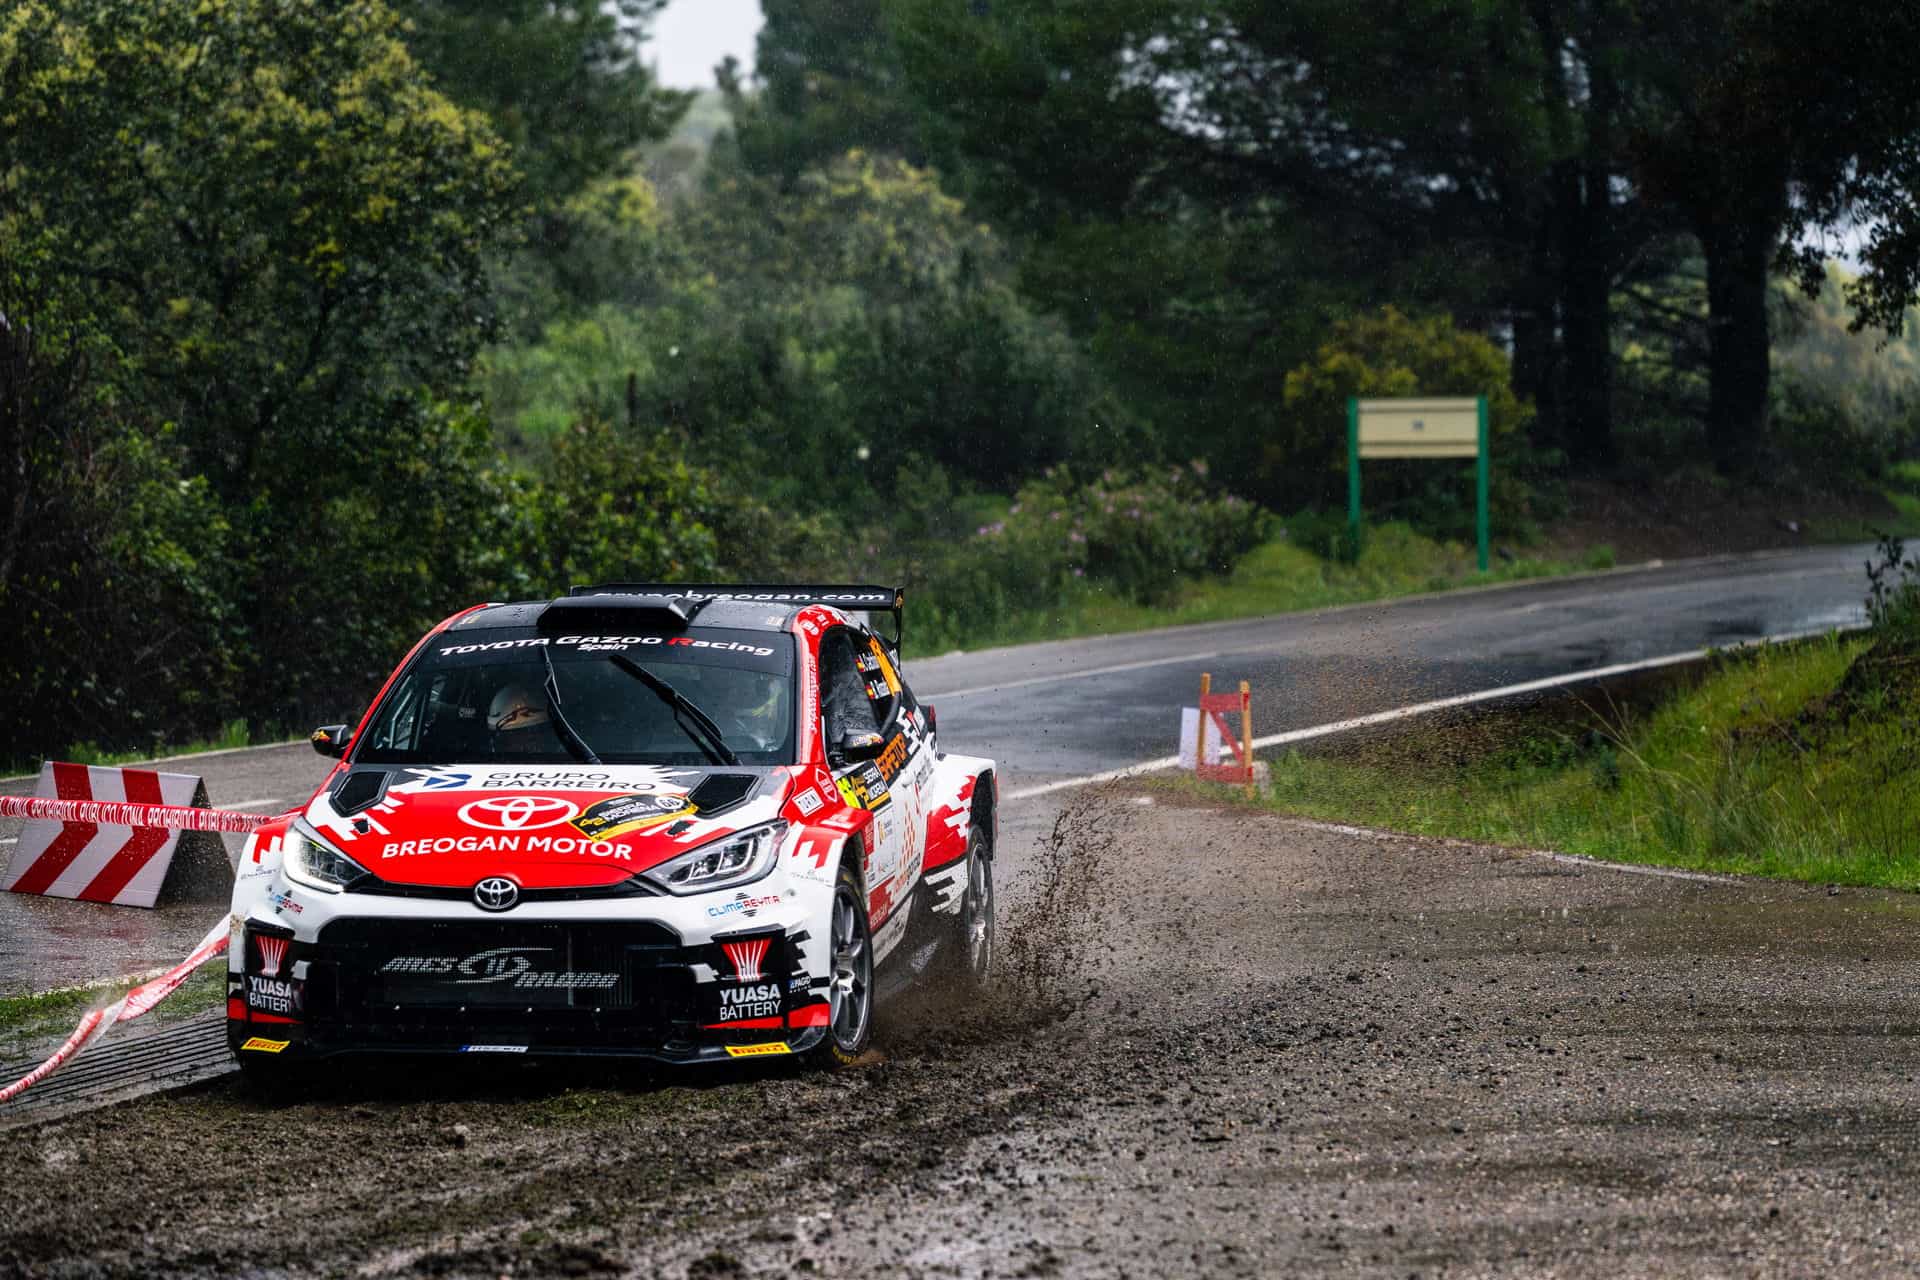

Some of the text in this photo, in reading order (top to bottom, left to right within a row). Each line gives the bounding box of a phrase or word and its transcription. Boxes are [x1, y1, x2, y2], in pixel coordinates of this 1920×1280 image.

[593, 589, 885, 600] obreogan.com
[440, 636, 774, 656] TOYOTA GAZOO Racing
[577, 643, 629, 652] Spain
[481, 780, 656, 791] BARREIRO
[487, 772, 611, 780] GRUPO
[382, 837, 632, 861] BREOGAN MOTOR
[249, 976, 292, 999] YUASA
[720, 983, 781, 1005] YUASA
[720, 1000, 781, 1021] BATTERY
